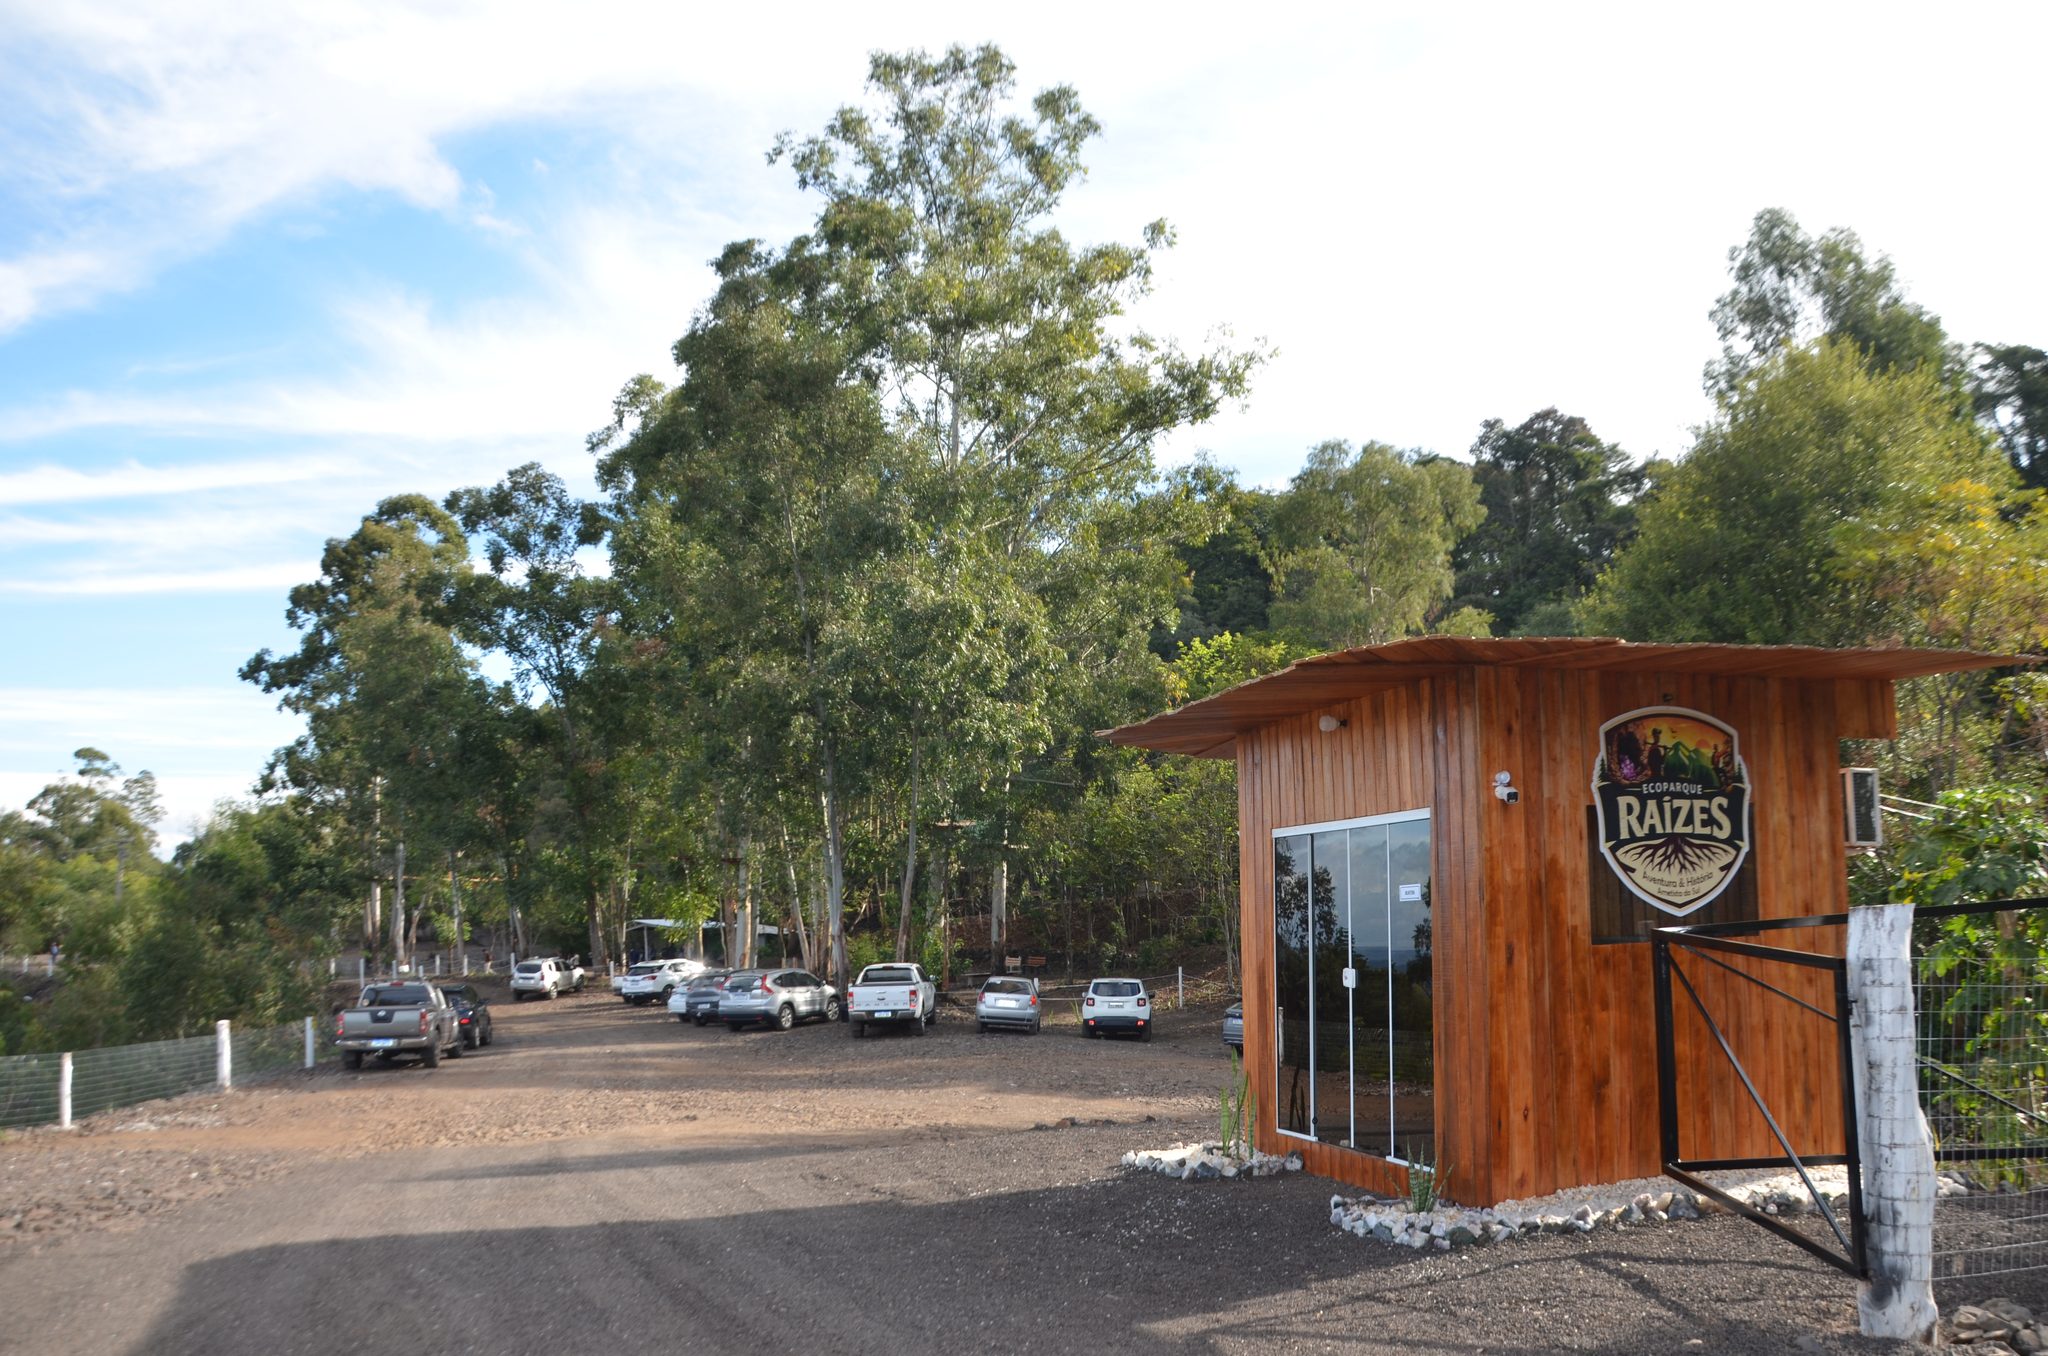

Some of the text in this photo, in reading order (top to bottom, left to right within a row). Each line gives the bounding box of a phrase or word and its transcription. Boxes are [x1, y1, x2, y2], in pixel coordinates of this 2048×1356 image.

[1642, 783, 1703, 795] ECOPARQUE
[1616, 796, 1732, 840] RAÍZES
[1643, 871, 1678, 888] Aventura
[1679, 878, 1685, 887] &
